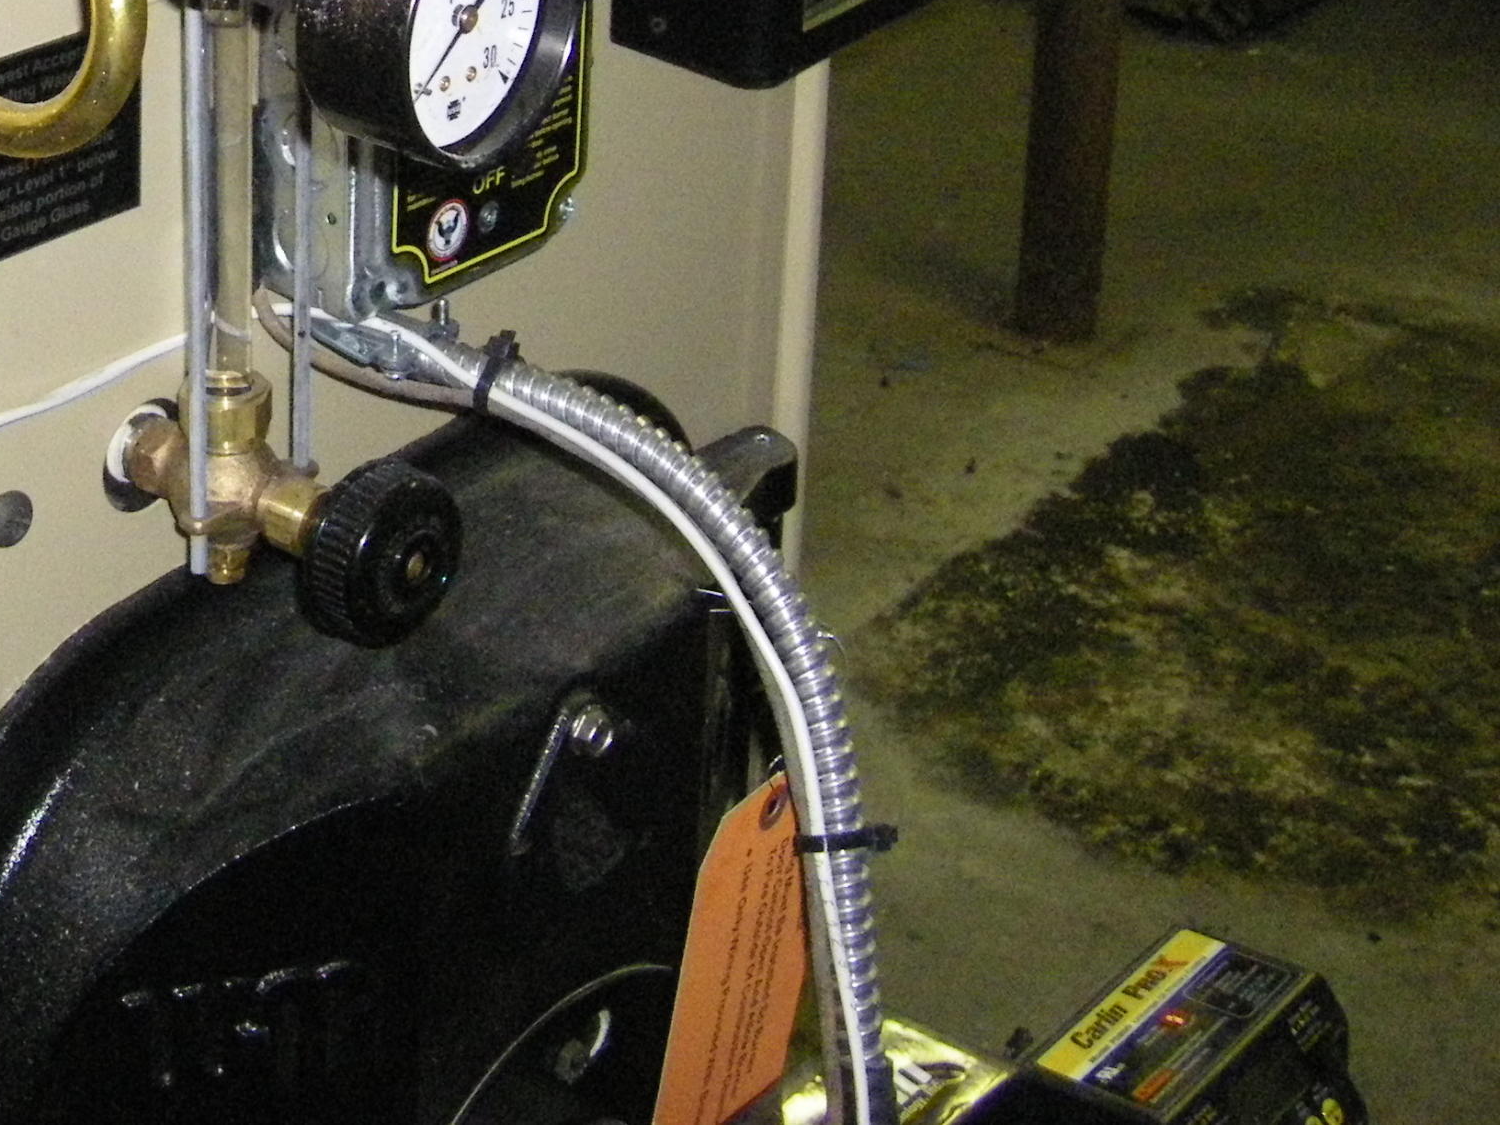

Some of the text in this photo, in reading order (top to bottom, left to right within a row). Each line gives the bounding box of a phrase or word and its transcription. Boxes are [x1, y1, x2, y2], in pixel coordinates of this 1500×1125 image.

[482, 44, 498, 70] 30
[15, 170, 55, 195] Level
[35, 180, 87, 213] portion
[89, 170, 106, 189] of
[472, 166, 506, 195] OFF
[0, 199, 91, 242] Gauge Glass
[1070, 1001, 1128, 1050] Carlin
